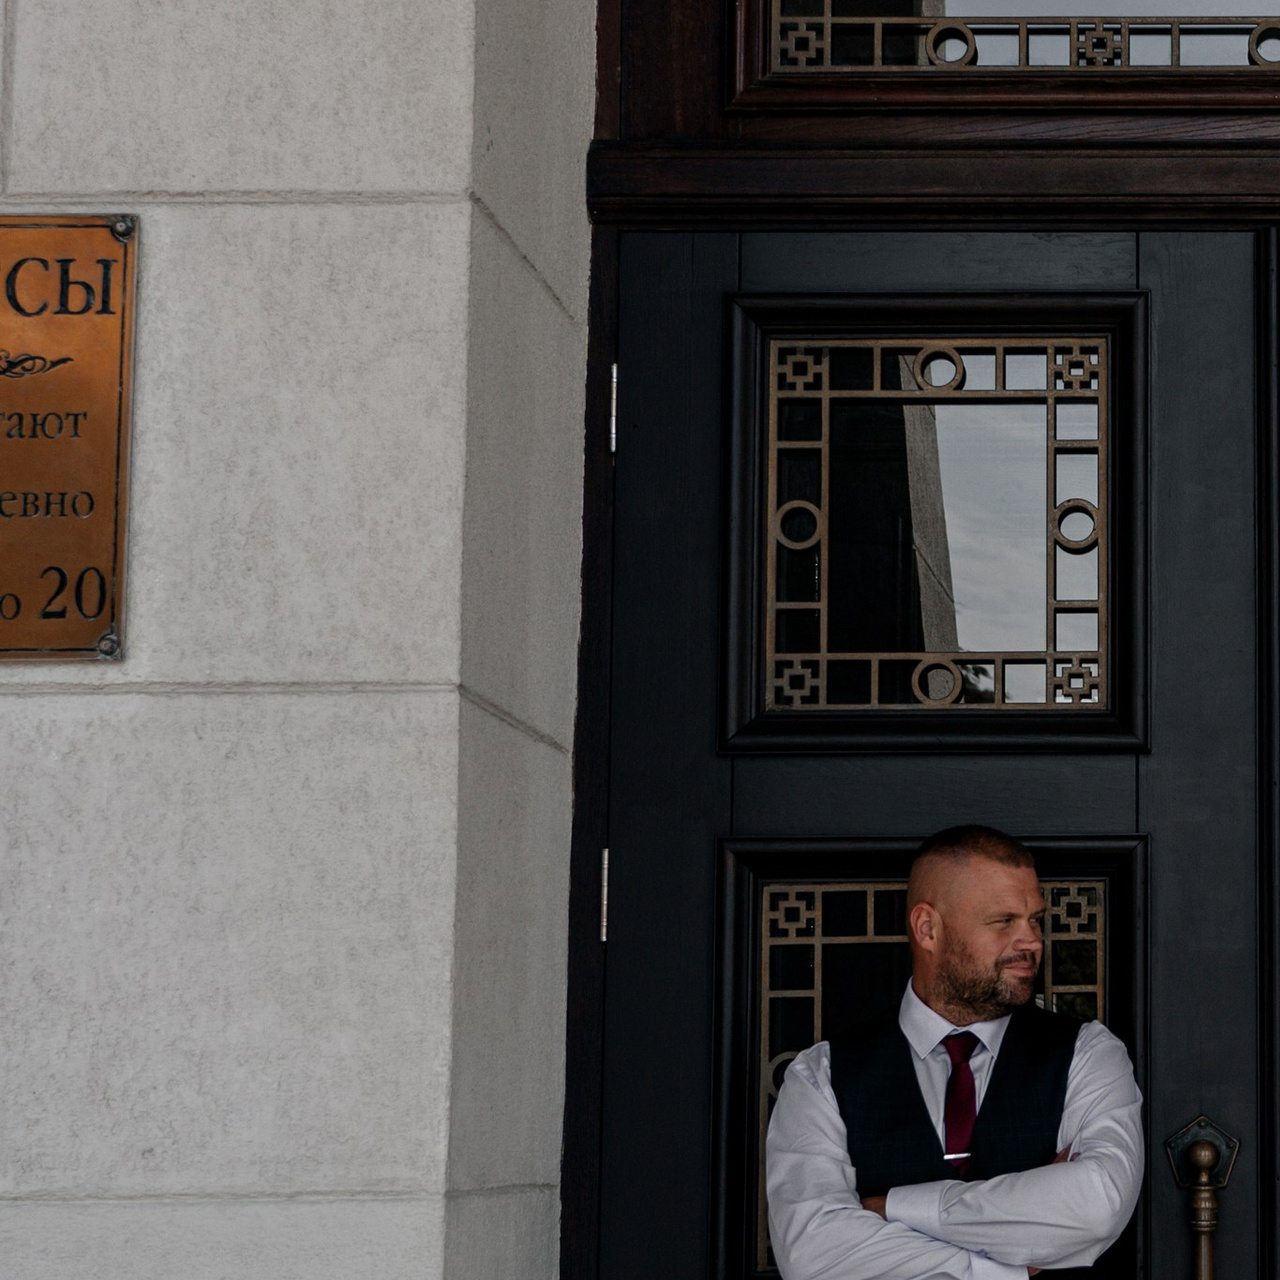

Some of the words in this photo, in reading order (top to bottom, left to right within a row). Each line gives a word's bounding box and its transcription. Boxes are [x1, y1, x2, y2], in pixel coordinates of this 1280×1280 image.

[6, 257, 118, 317] СЫ
[0, 411, 88, 439] ают
[38, 565, 107, 620] 20
